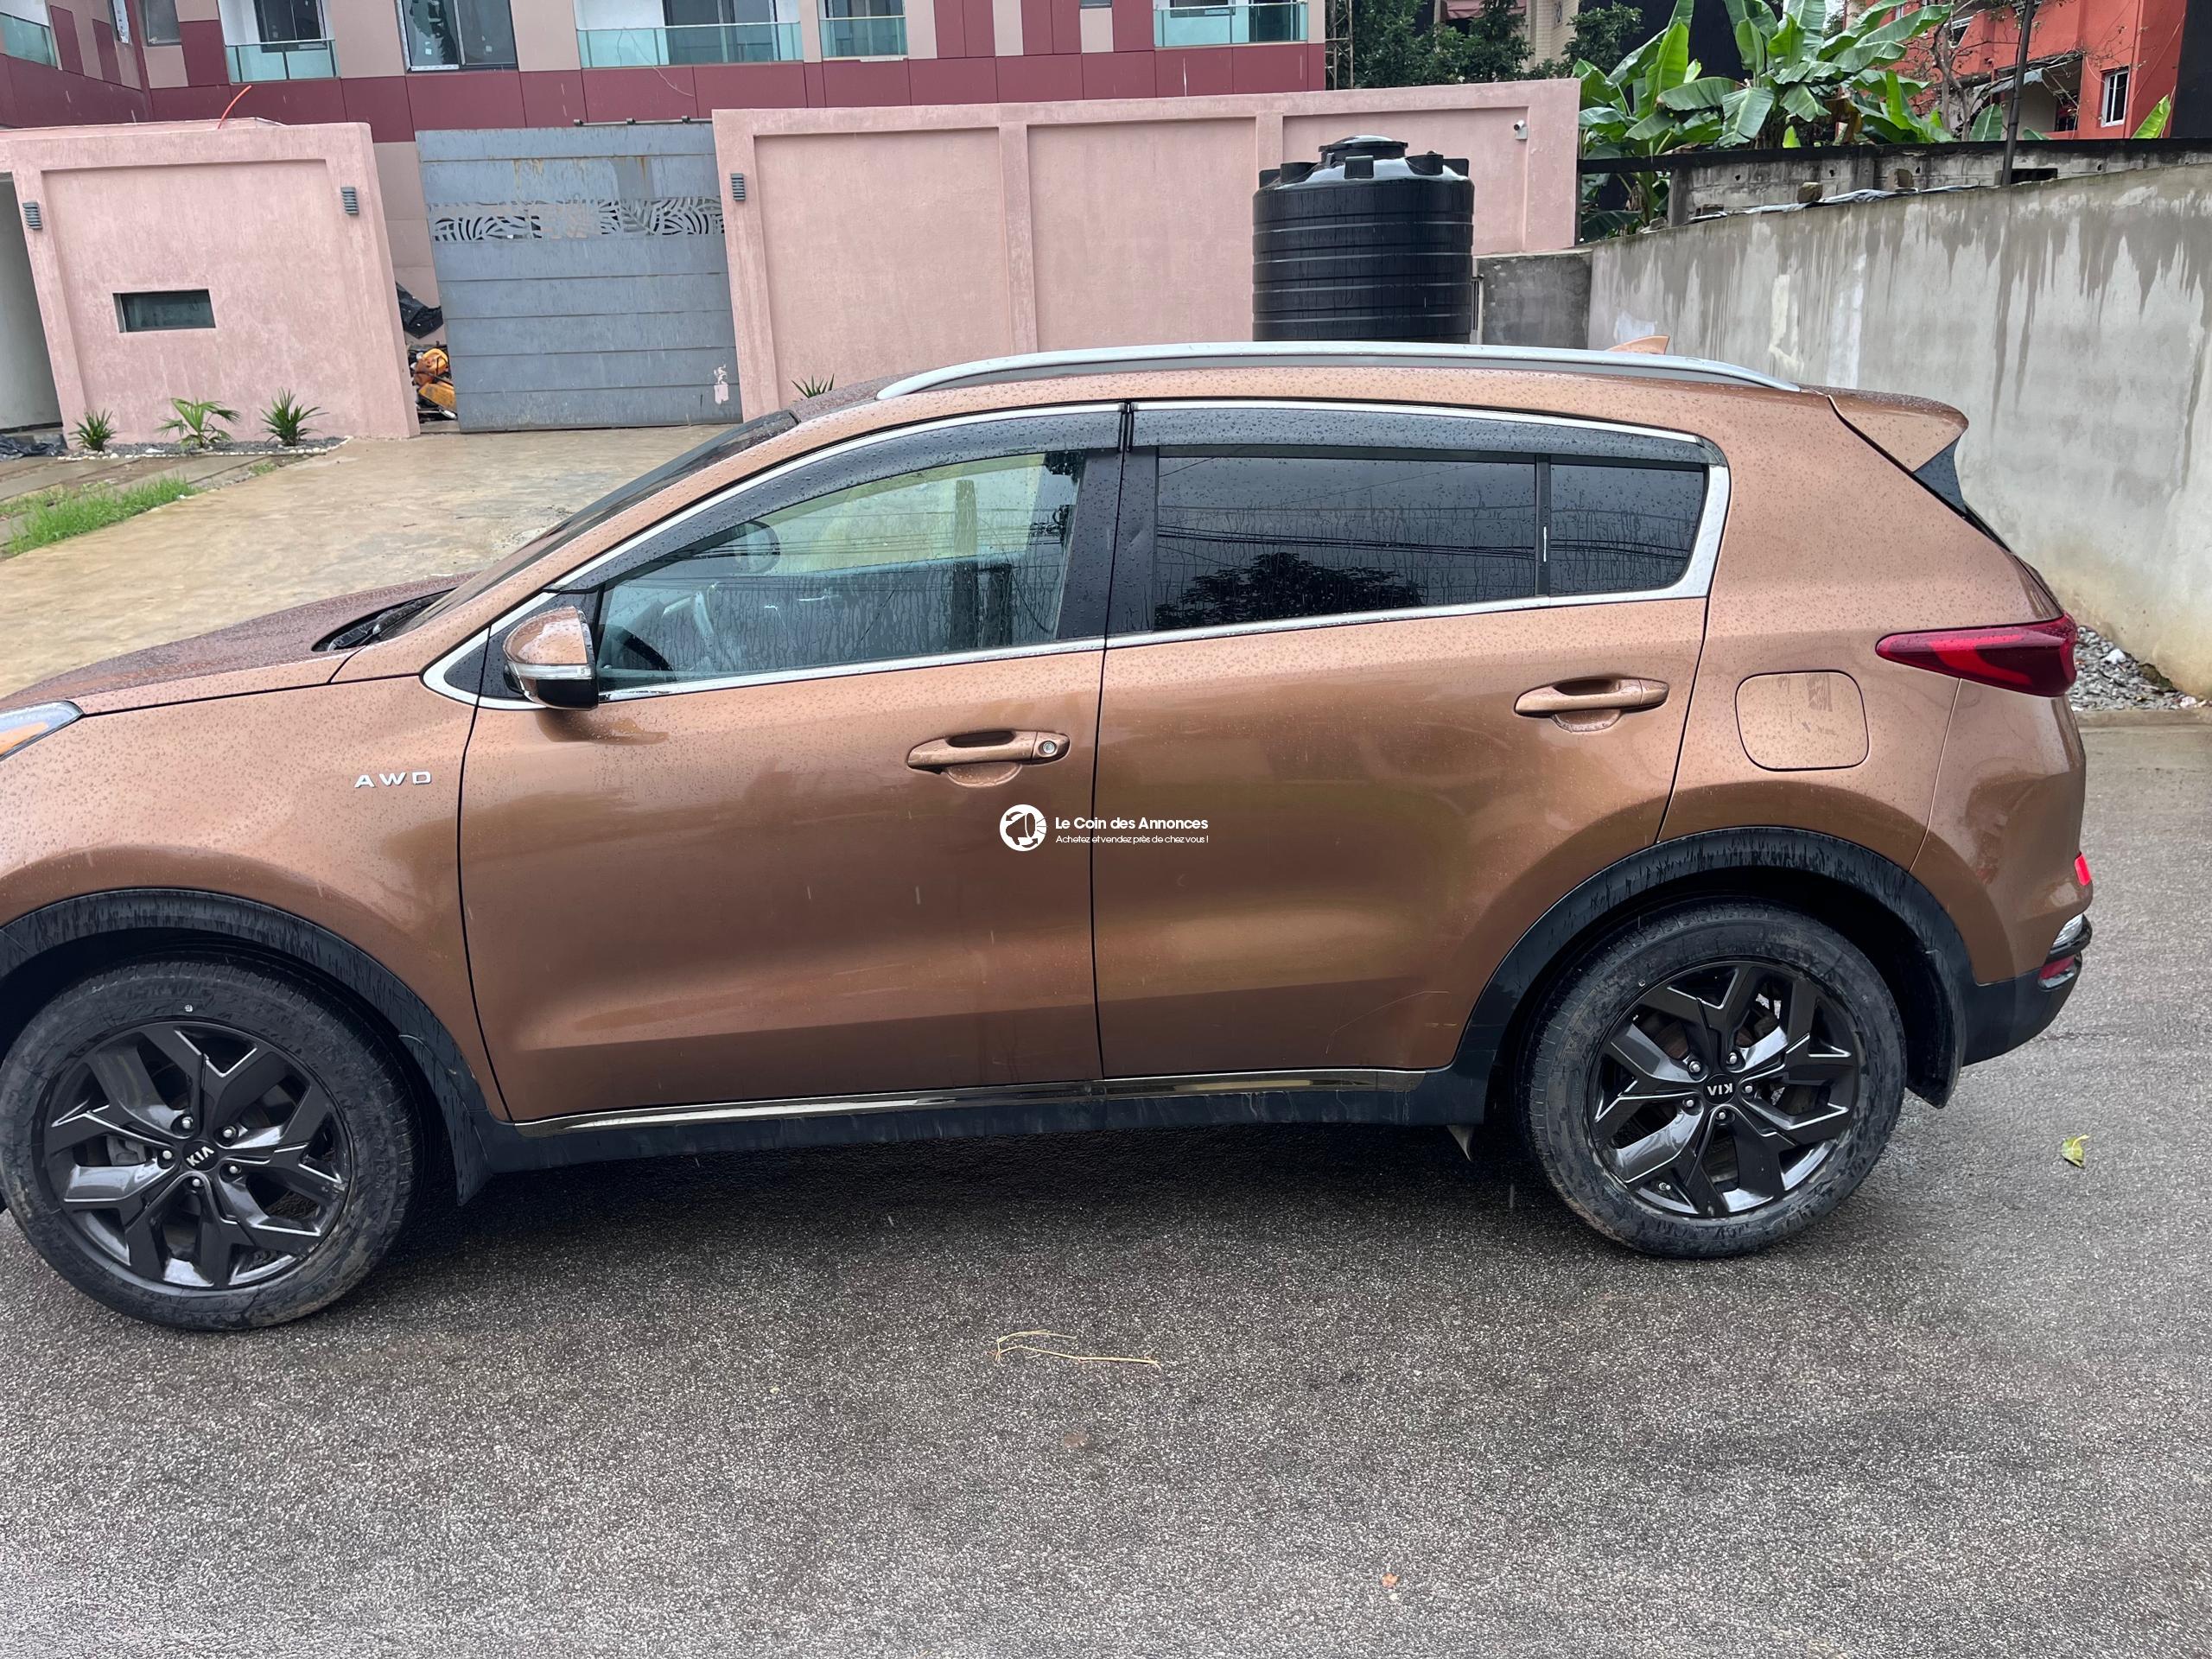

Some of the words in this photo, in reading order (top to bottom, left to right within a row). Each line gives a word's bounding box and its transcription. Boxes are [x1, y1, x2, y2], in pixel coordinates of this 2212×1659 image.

[353, 771, 431, 788] AWD
[1707, 1083, 1733, 1096] KIA
[186, 1146, 215, 1166] KIA
